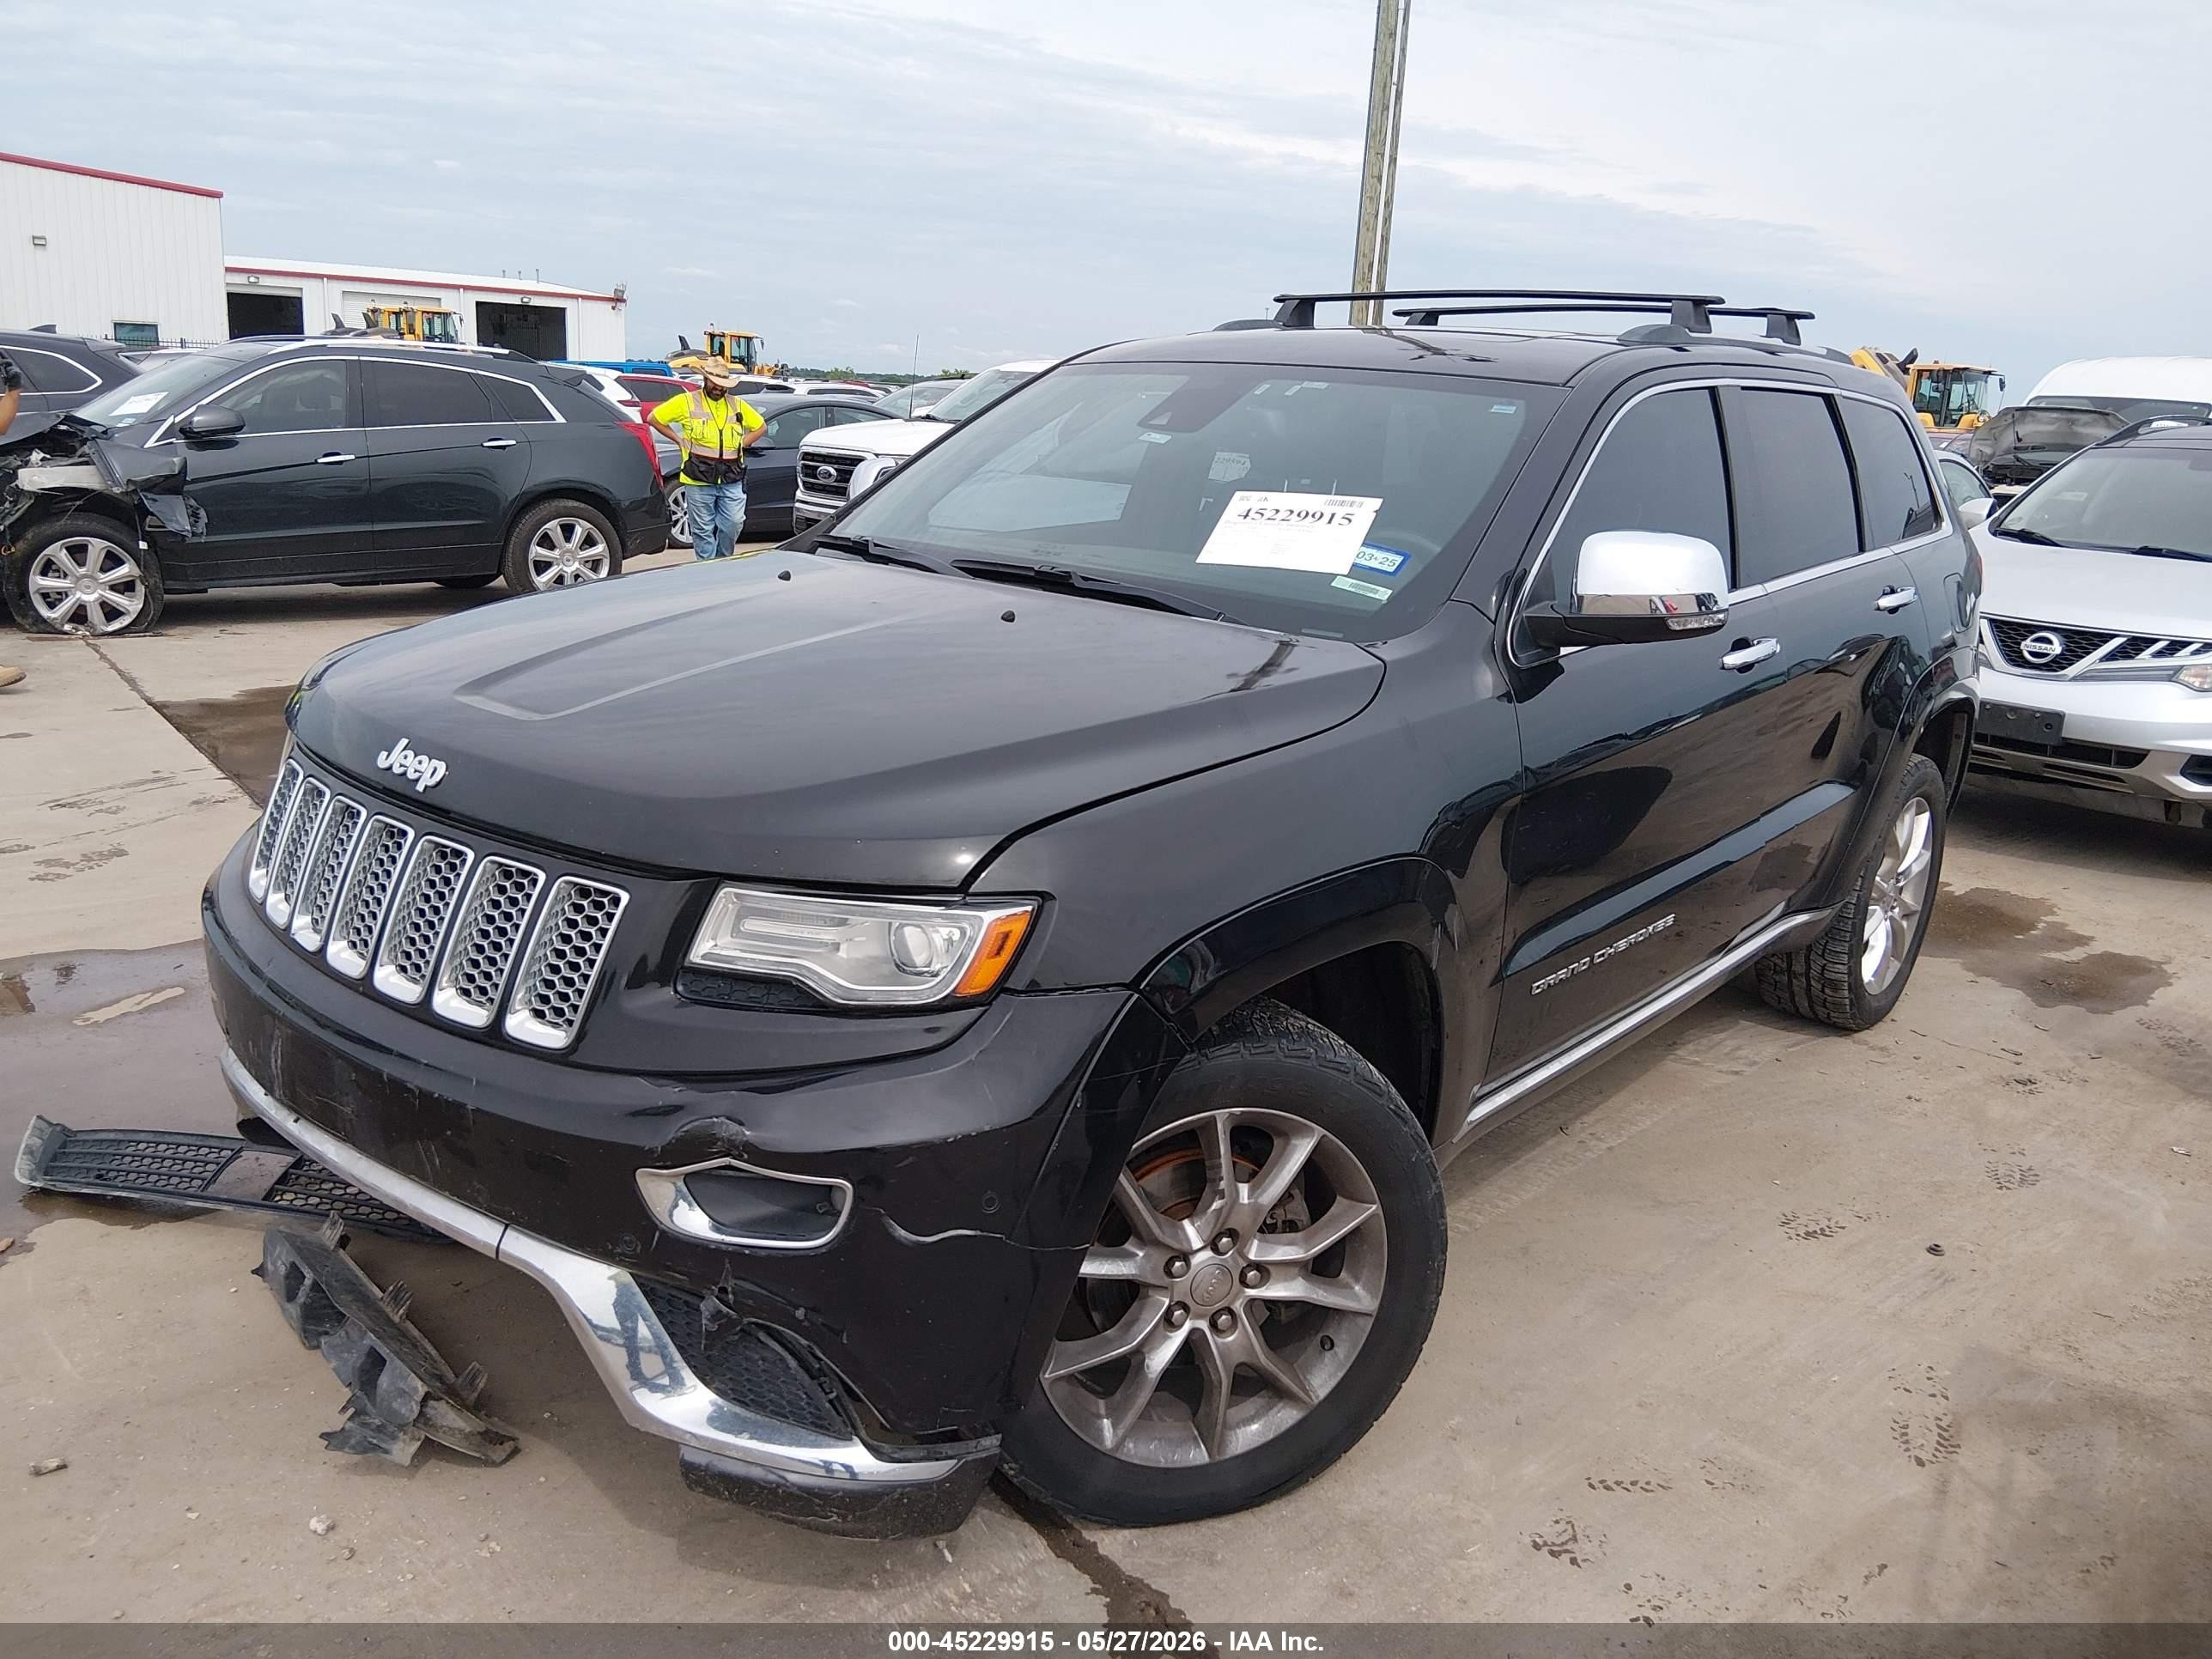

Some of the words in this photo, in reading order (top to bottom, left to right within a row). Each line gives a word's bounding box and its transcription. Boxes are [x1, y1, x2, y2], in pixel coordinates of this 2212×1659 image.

[1238, 507, 1355, 526] 45229915
[1378, 556, 1398, 567] 25
[2024, 644, 2057, 653] NISSAN
[377, 738, 447, 793] Jeep
[1531, 957, 1590, 995] GRAND
[1594, 913, 1675, 964] CHEROKEE
